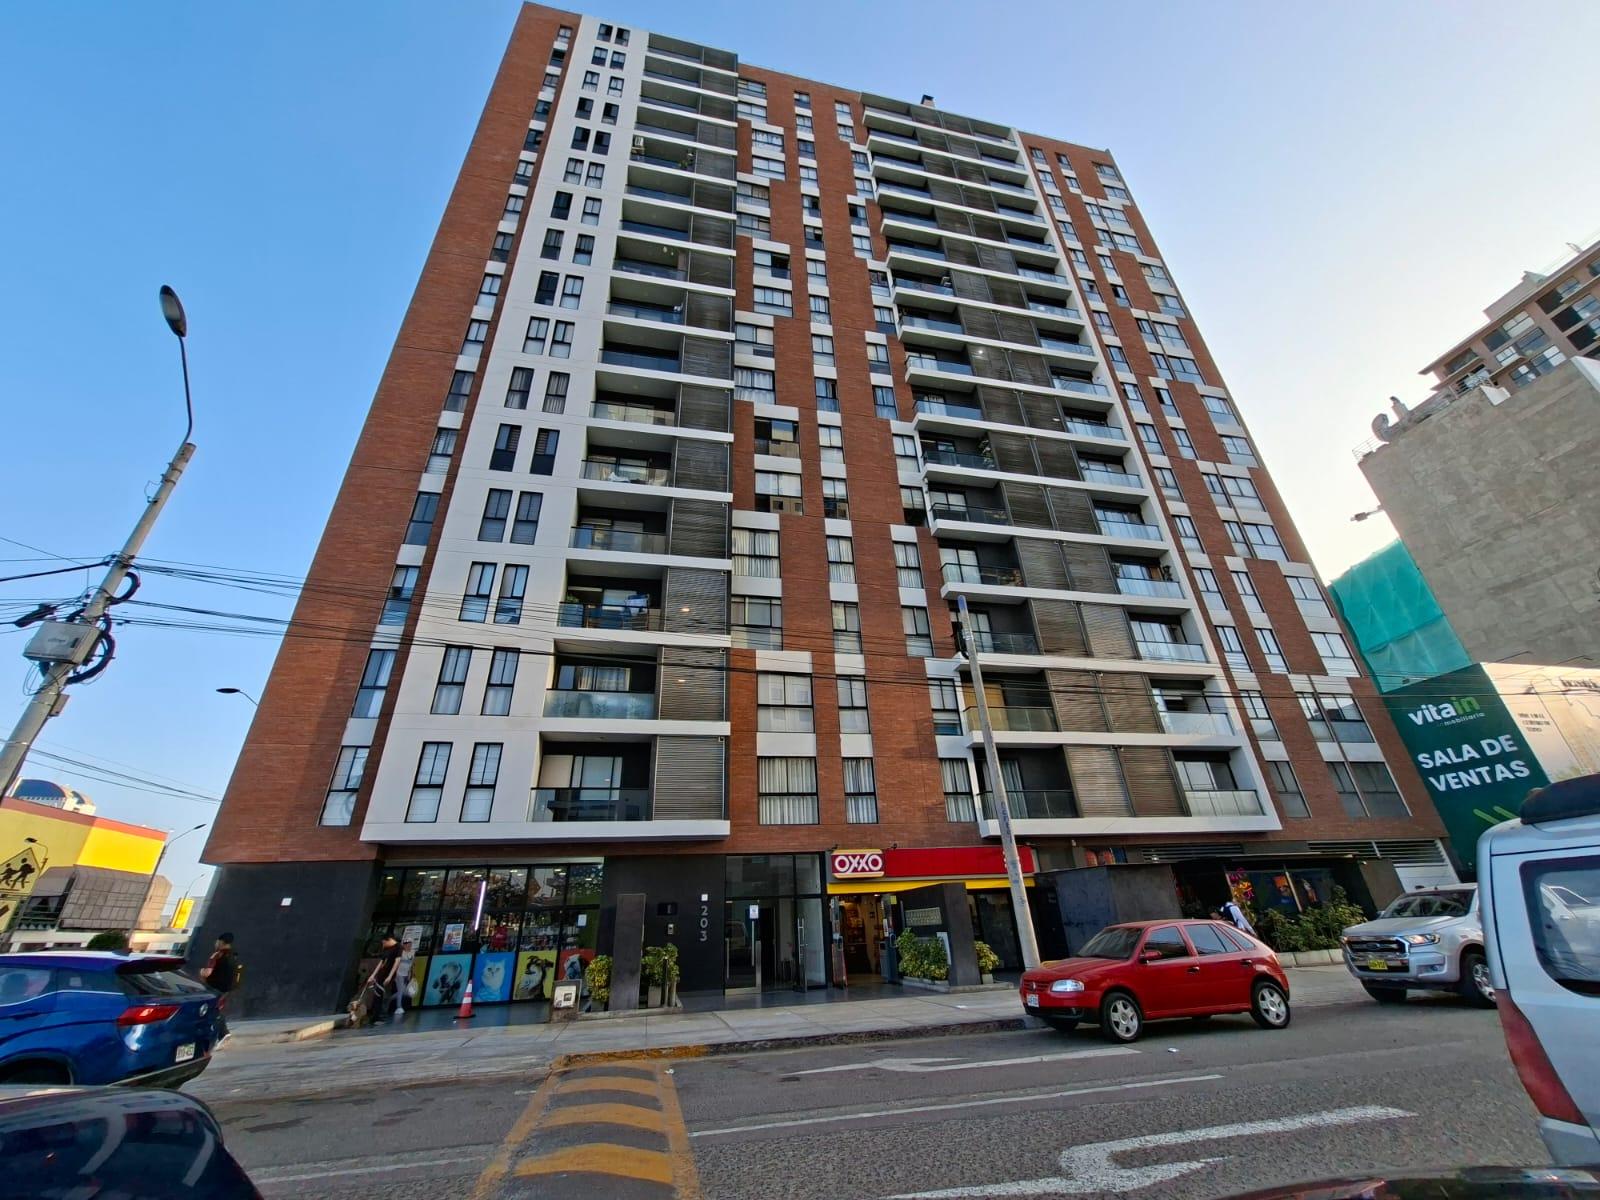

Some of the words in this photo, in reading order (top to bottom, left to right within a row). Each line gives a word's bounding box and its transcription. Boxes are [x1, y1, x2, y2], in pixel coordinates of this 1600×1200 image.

[1408, 696, 1480, 725] vitain
[1417, 744, 1480, 769] SALA
[1480, 734, 1518, 756] DE
[1428, 760, 1530, 791] VENTAS
[834, 853, 883, 874] OXXO
[699, 905, 709, 941] 203
